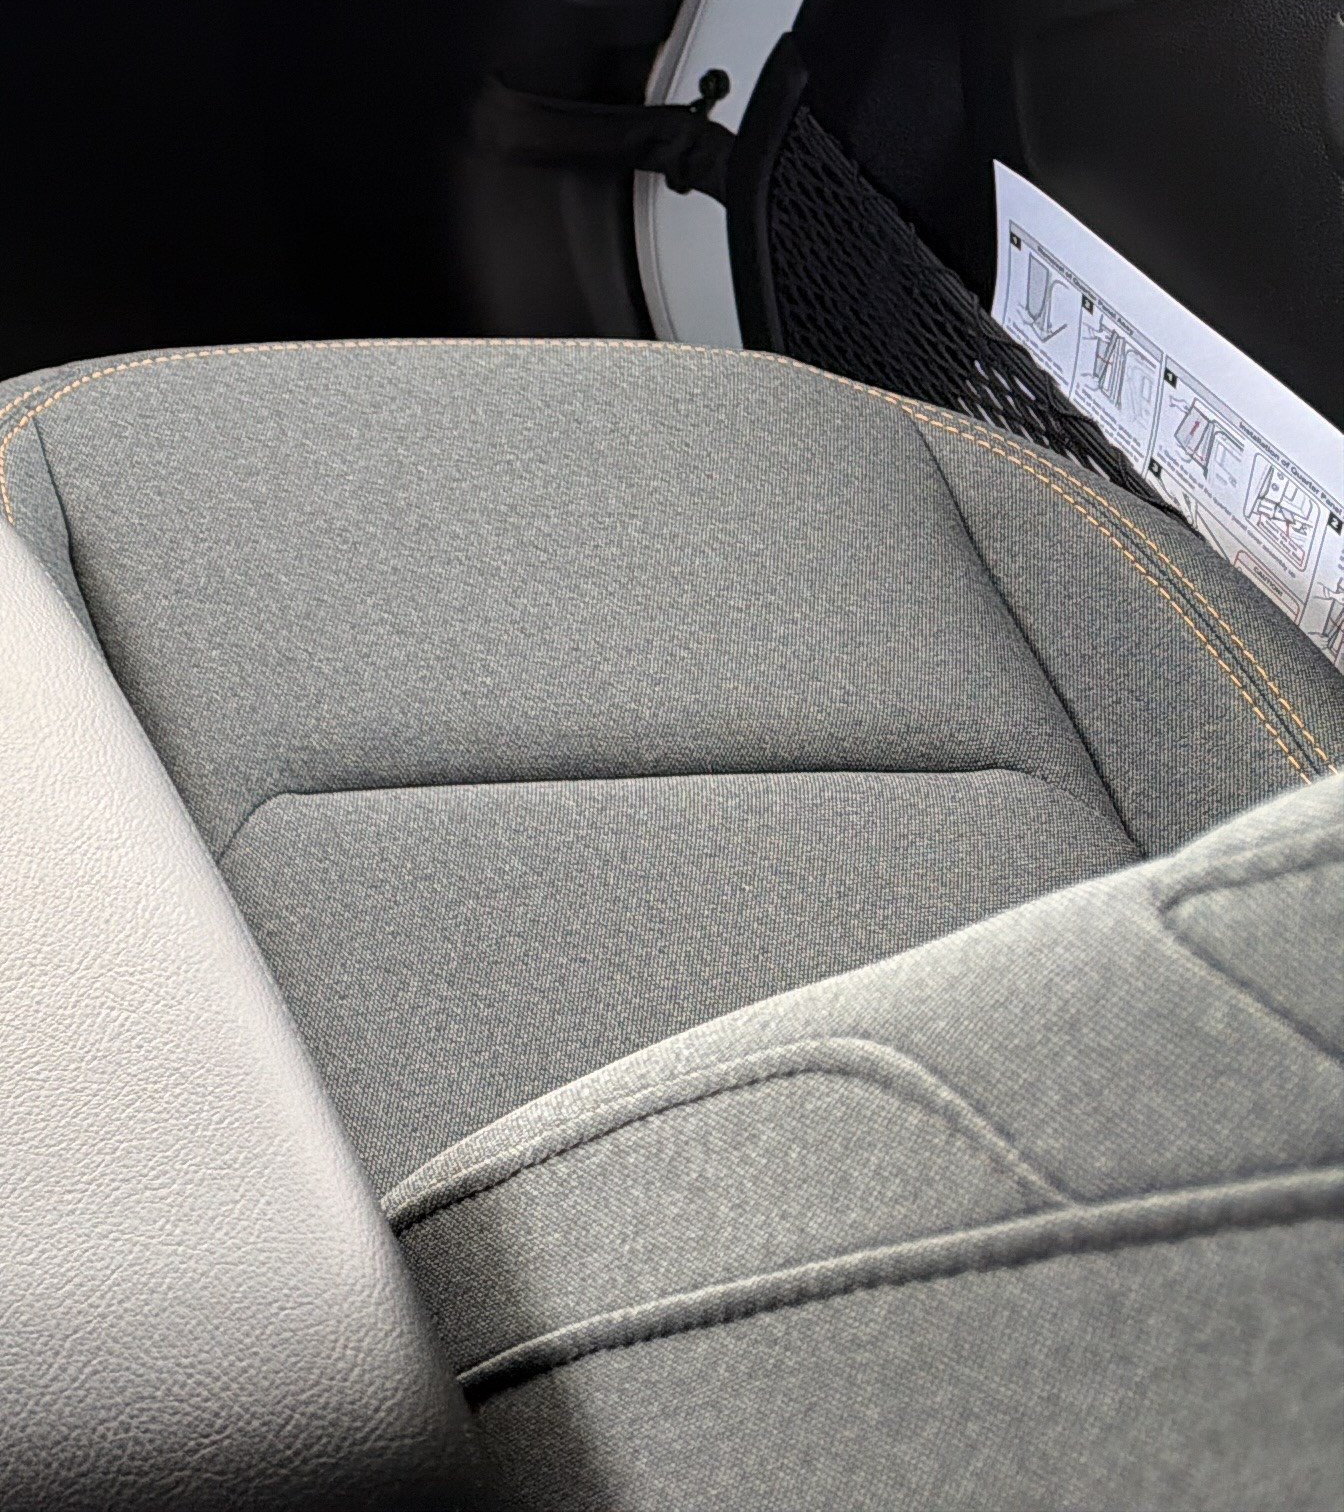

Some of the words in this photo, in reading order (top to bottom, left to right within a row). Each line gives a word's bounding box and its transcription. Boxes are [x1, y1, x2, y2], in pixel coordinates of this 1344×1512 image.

[1239, 421, 1280, 461] Installation
[1280, 457, 1290, 468] of
[1290, 466, 1320, 495] Quarter
[1320, 493, 1343, 516] Panel
